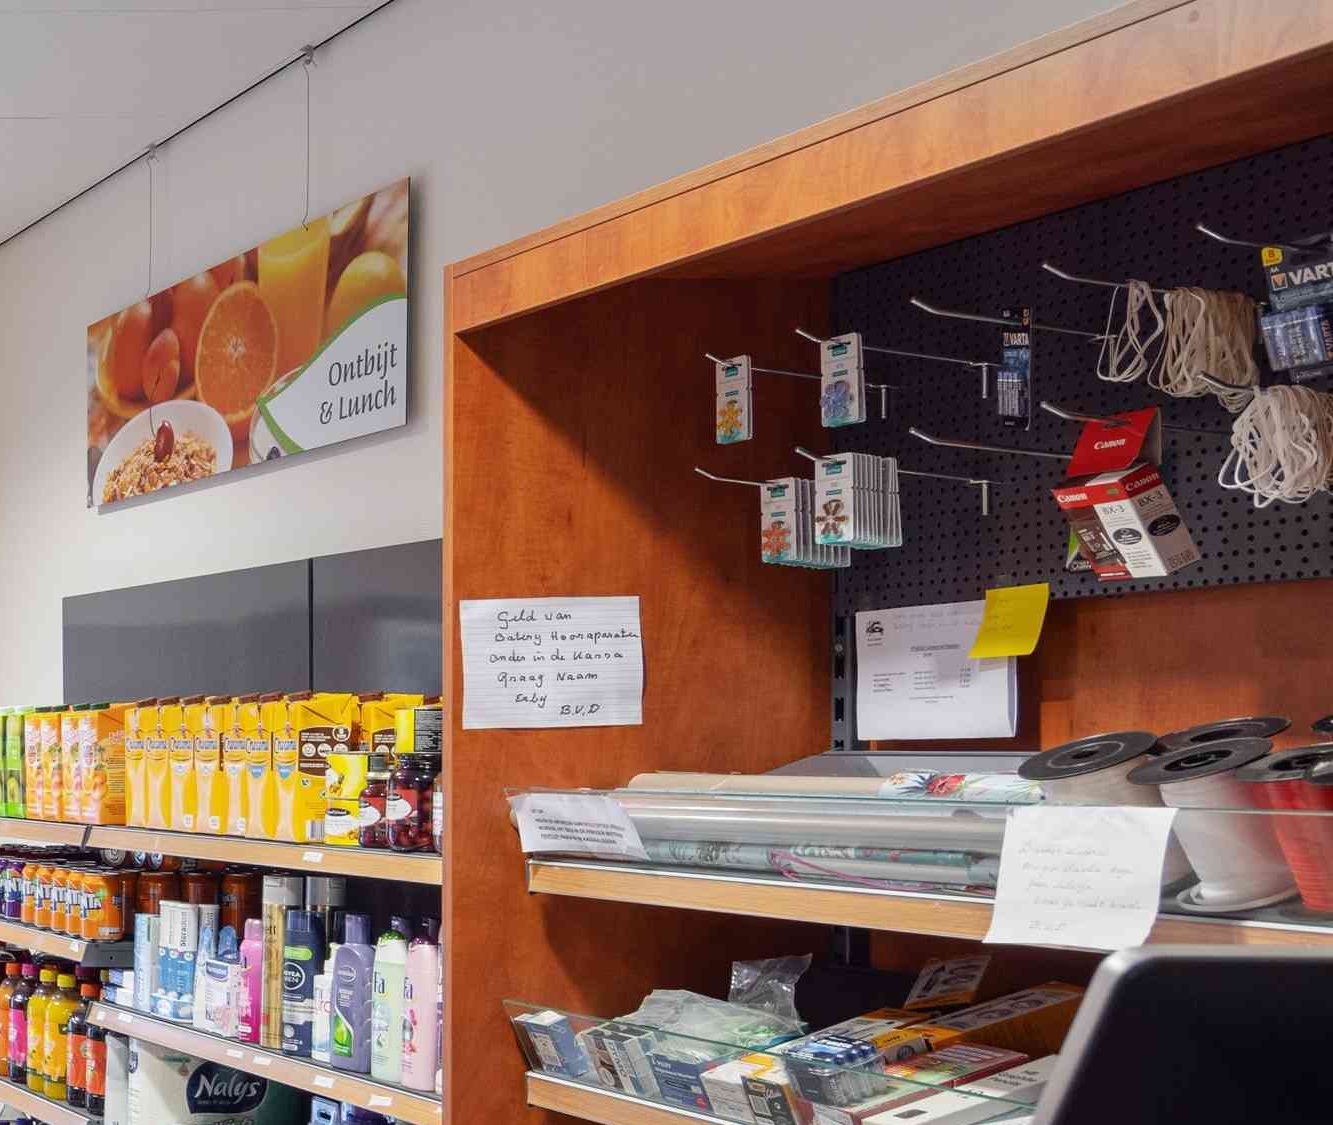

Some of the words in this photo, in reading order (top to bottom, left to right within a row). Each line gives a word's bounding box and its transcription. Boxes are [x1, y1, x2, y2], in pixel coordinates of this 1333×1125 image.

[1286, 262, 1333, 287] VART
[328, 342, 397, 386] Ontbijt
[319, 401, 333, 425] &
[339, 380, 397, 420] Lunch
[1094, 438, 1126, 450] Canon
[1125, 472, 1160, 492] Canon
[1057, 492, 1088, 504] Canon
[545, 612, 572, 621] van
[533, 651, 545, 662] in
[550, 652, 566, 662] de
[556, 672, 599, 682] Naam
[194, 1072, 262, 1104] Nalys
